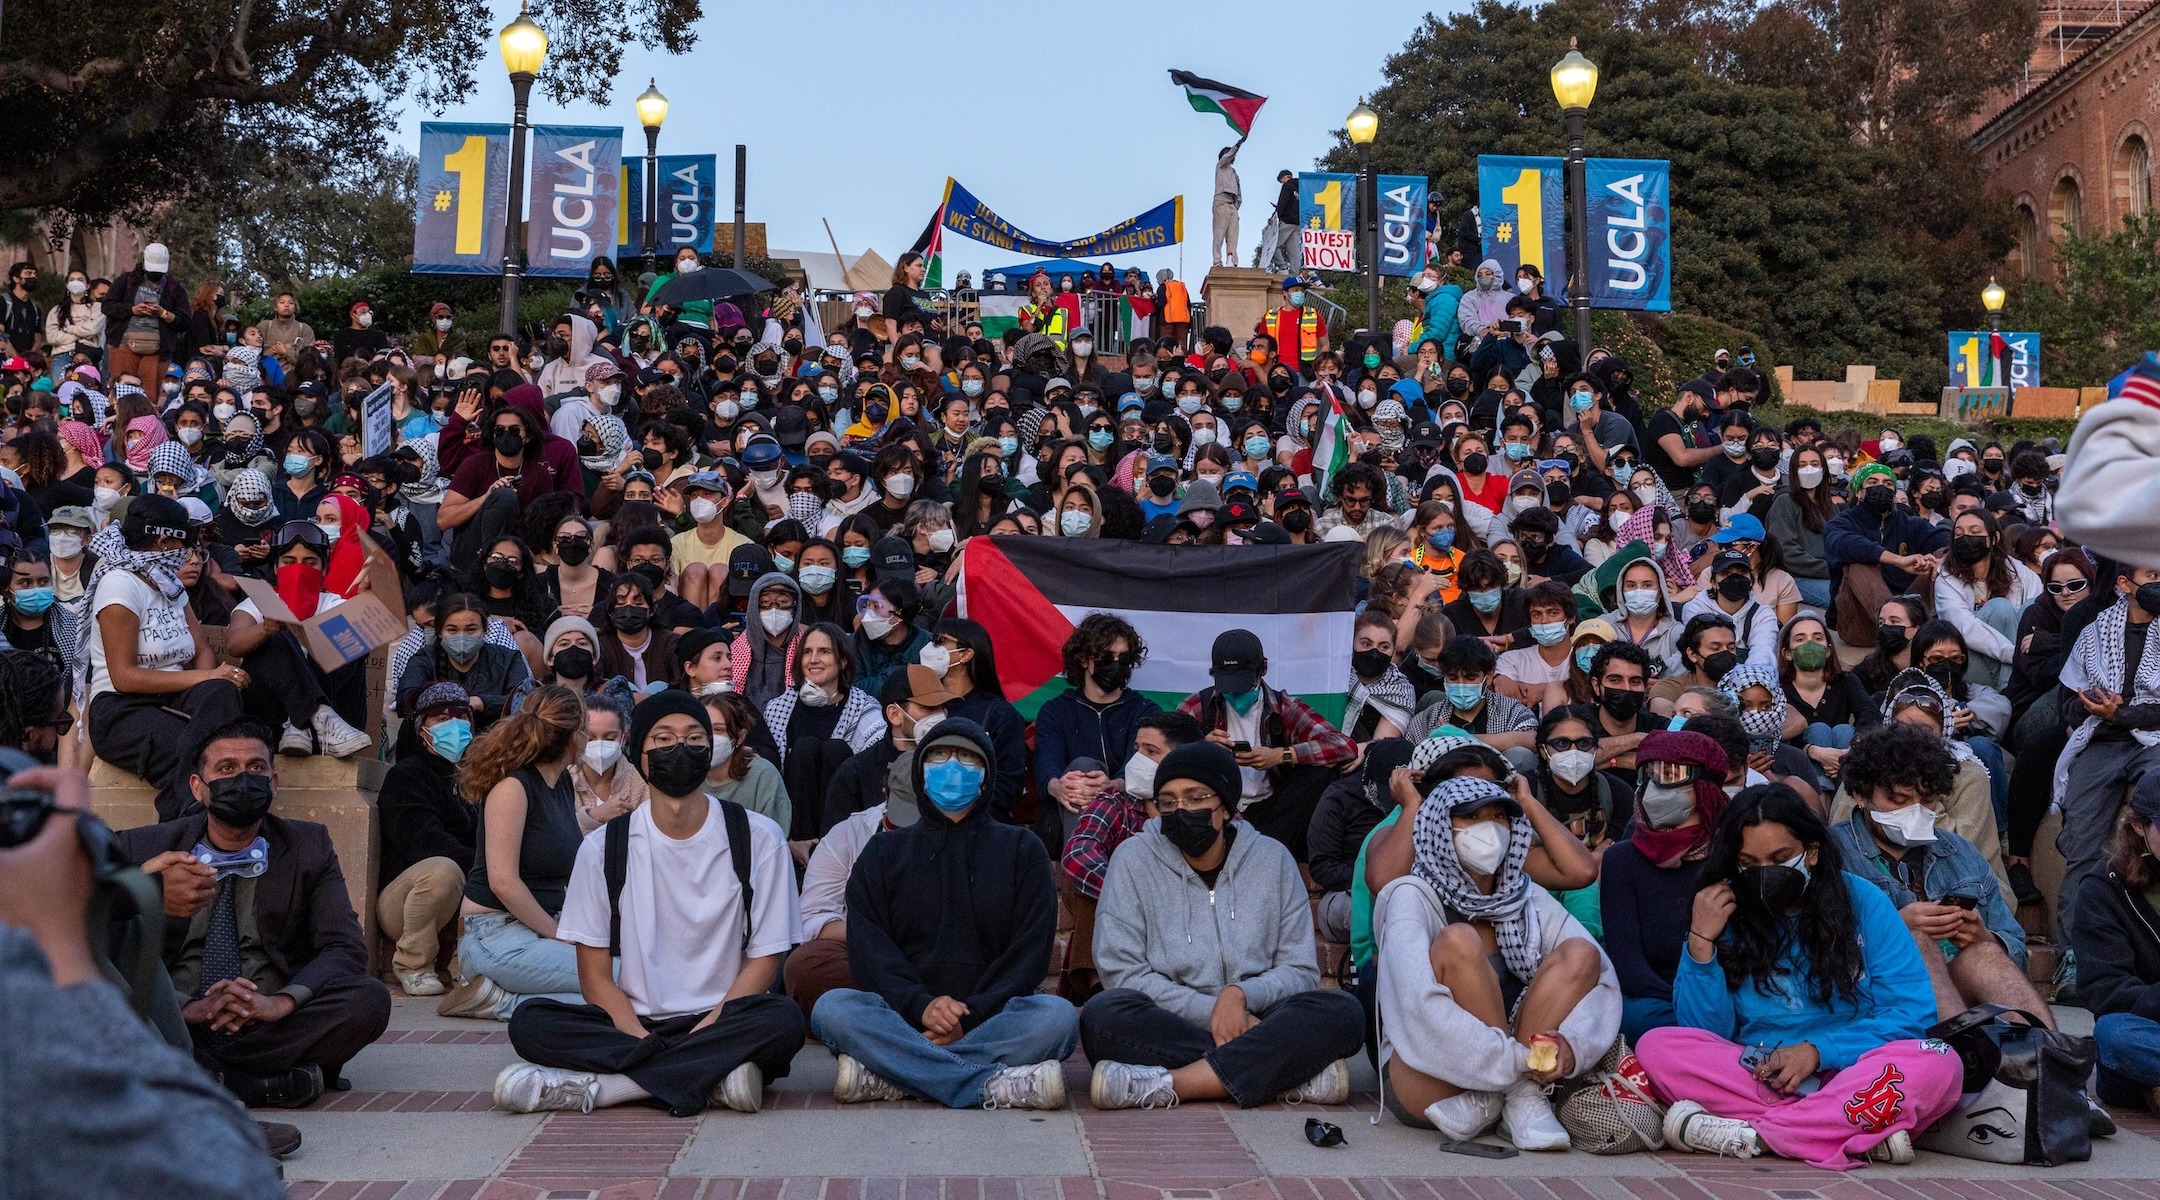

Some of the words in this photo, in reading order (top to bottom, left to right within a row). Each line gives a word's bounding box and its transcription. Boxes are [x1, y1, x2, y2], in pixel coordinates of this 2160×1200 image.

[433, 135, 487, 255] #1
[550, 140, 596, 260] UCLA
[671, 163, 699, 243] UCLA
[975, 202, 1009, 234] UCLA
[949, 210, 970, 233] WE
[972, 221, 1014, 250] STAND
[1094, 226, 1165, 255] STUDENTS
[1304, 231, 1352, 248] DIVEST
[1384, 185, 1411, 265] UCLA
[1497, 169, 1543, 279] #1
[1606, 173, 1647, 290] UCLA
[1304, 246, 1351, 269] NOW
[1956, 337, 1980, 388] #1
[733, 561, 760, 571] UCLA
[885, 555, 908, 564] UCLA
[146, 605, 178, 625] FREE
